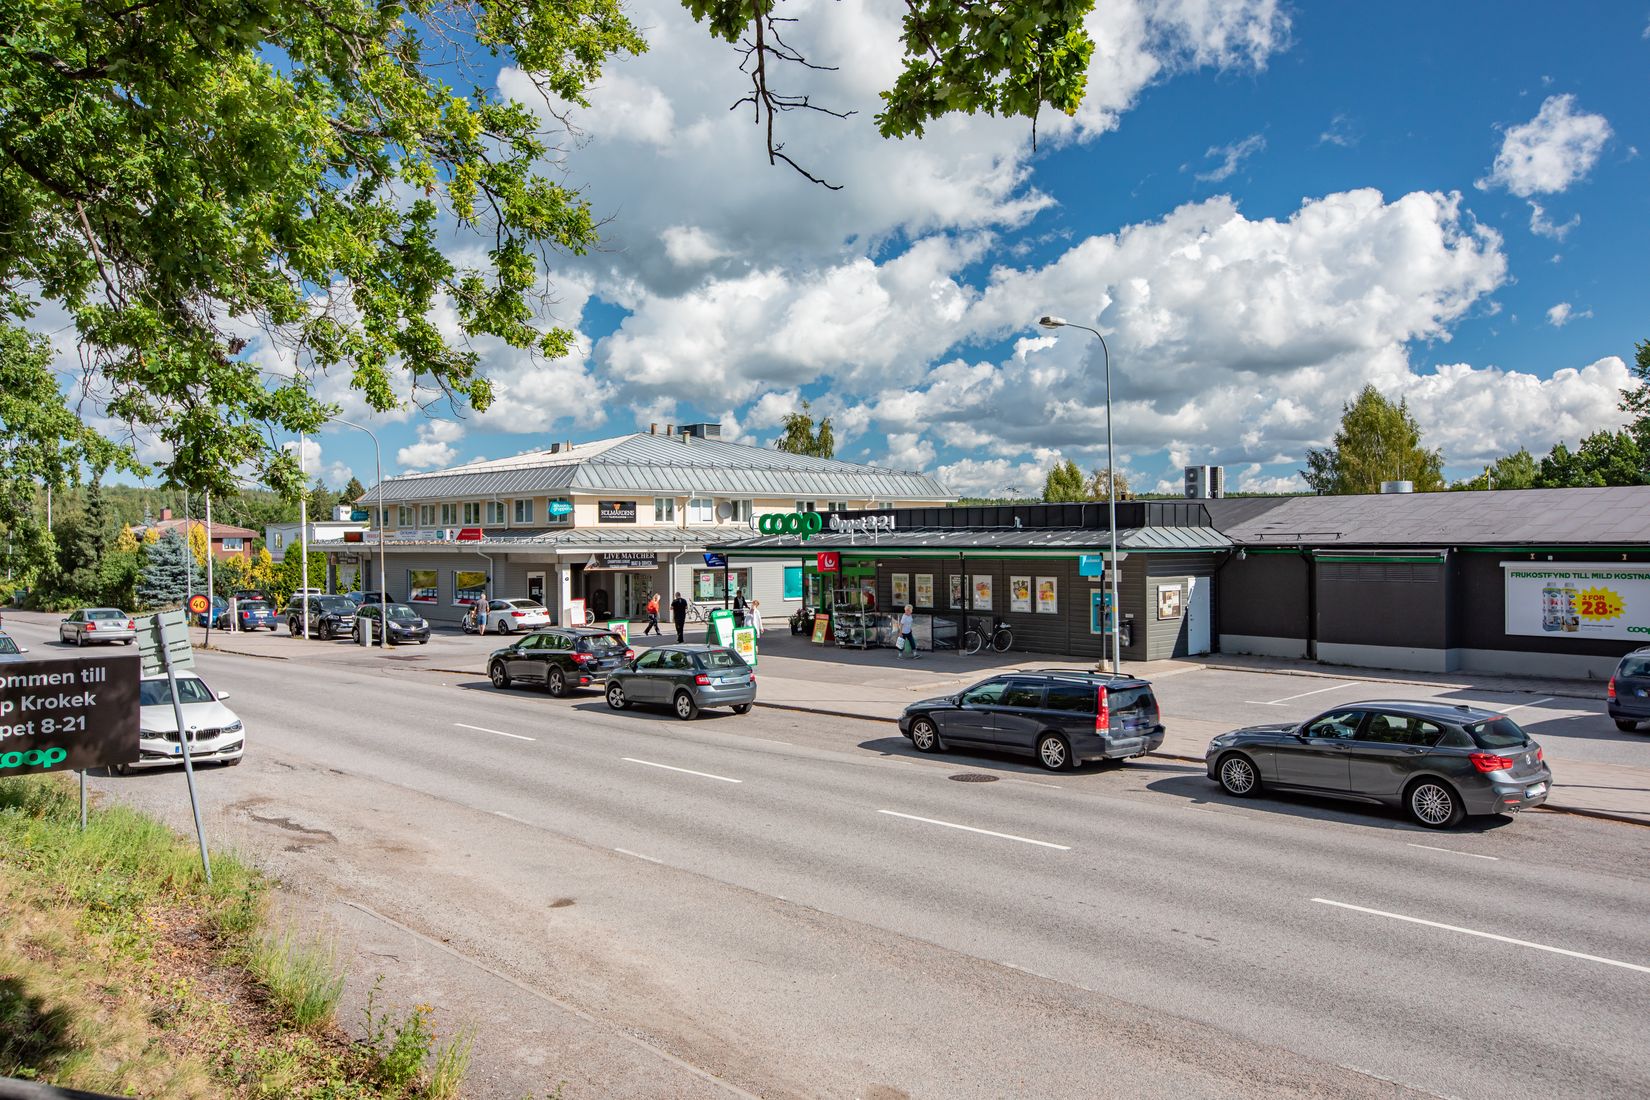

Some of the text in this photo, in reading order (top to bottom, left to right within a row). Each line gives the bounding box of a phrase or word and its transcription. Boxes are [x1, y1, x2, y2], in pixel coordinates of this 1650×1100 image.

[758, 511, 823, 541] coop
[1510, 571, 1570, 579] FRUKOSTFYND
[1591, 572, 1613, 580] MILD
[193, 600, 205, 609] 40
[1581, 601, 1620, 615] 28:-
[81, 667, 106, 684] till
[21, 692, 97, 711] Krokek
[41, 716, 86, 734] 8-21
